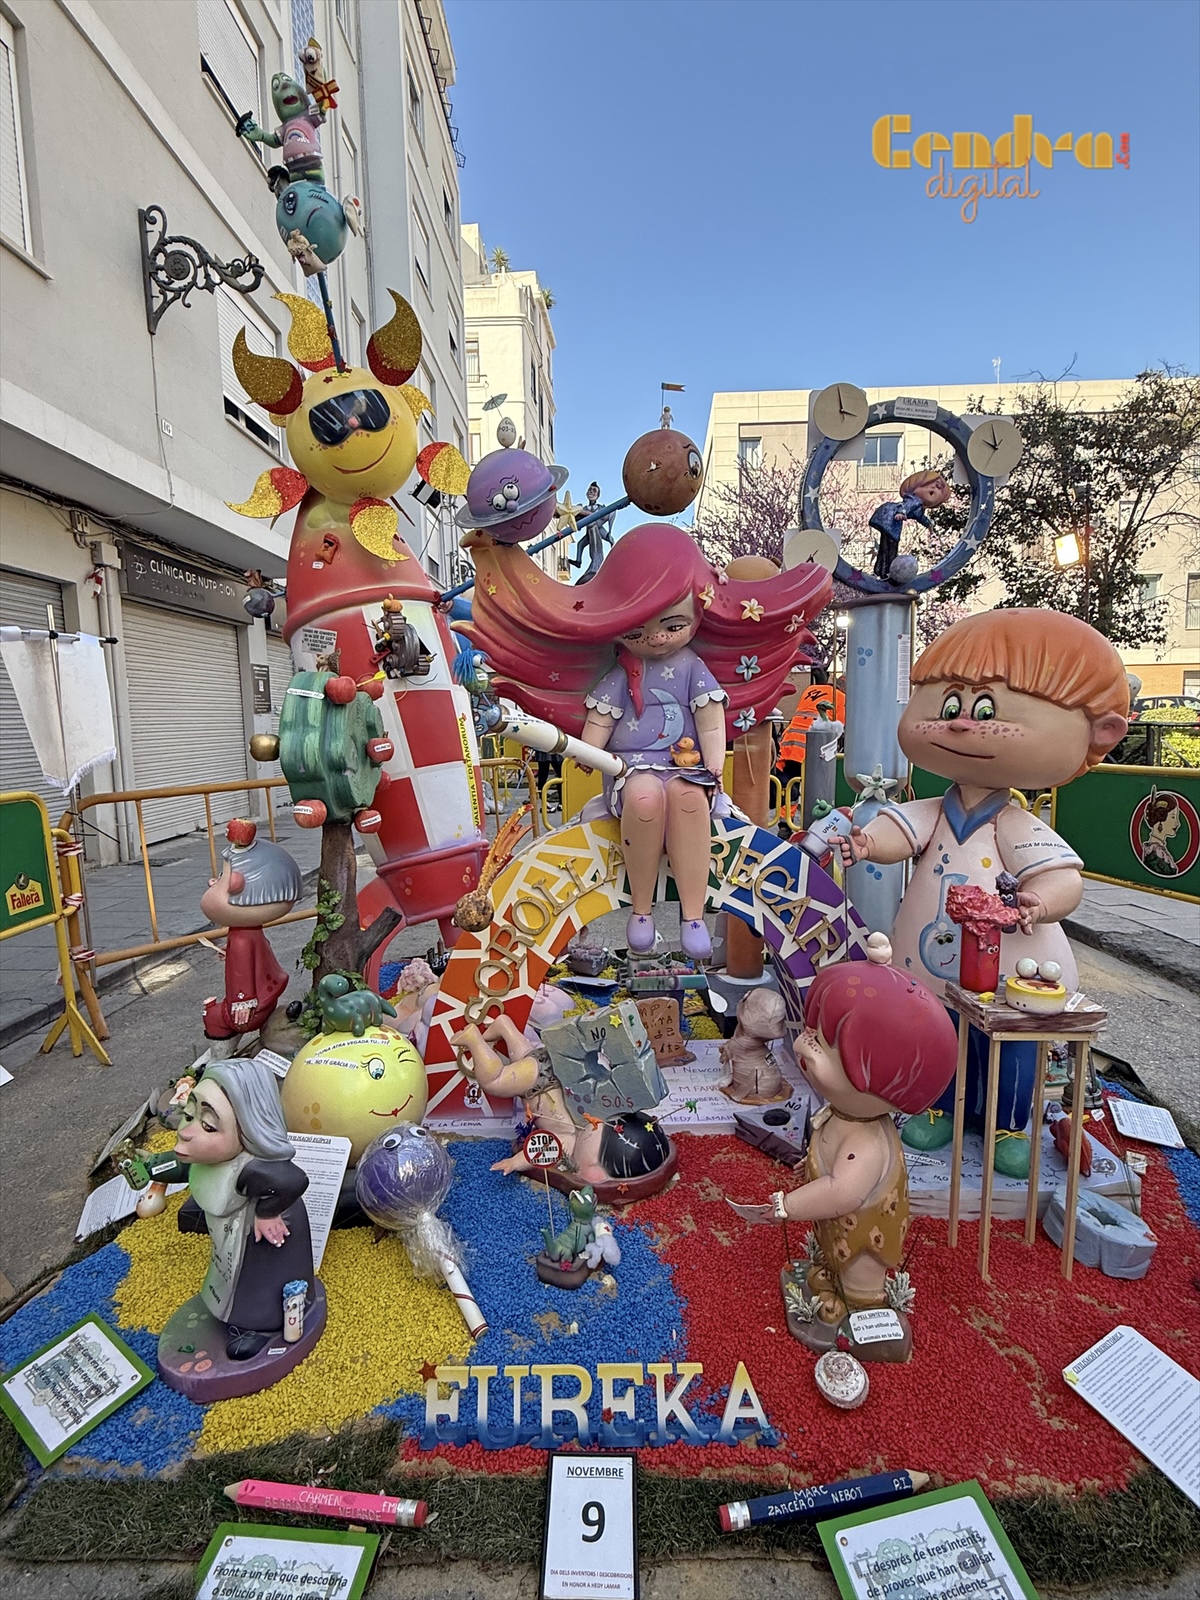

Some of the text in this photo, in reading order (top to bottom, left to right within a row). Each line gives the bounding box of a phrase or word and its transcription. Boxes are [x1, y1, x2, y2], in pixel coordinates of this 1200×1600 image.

[150, 559, 184, 581] CLÍNICA
[186, 572, 196, 585] DE
[10, 892, 41, 910] Fallera
[463, 837, 848, 1026] SOROLLA RECAR
[591, 1027, 606, 1040] NO
[785, 1101, 801, 1111] NO
[531, 1135, 553, 1145] STOP
[419, 1361, 780, 1450] EUREKA
[567, 1466, 624, 1478] NOVEMBRE
[299, 1490, 342, 1506] CARMEN
[794, 1485, 828, 1500] MARC
[831, 1487, 863, 1503] NEBOT
[581, 1501, 606, 1543] 9
[874, 1553, 912, 1573] després
[914, 1549, 926, 1561] de
[927, 1543, 947, 1557] tres
[213, 1565, 348, 1588] Front a un fet que descobria
[867, 1551, 995, 1598] de proves que han realisat
[212, 1587, 219, 1595] o
[221, 1583, 256, 1599] solució
[257, 1591, 263, 1599] a
[941, 1579, 987, 1600] accidents
